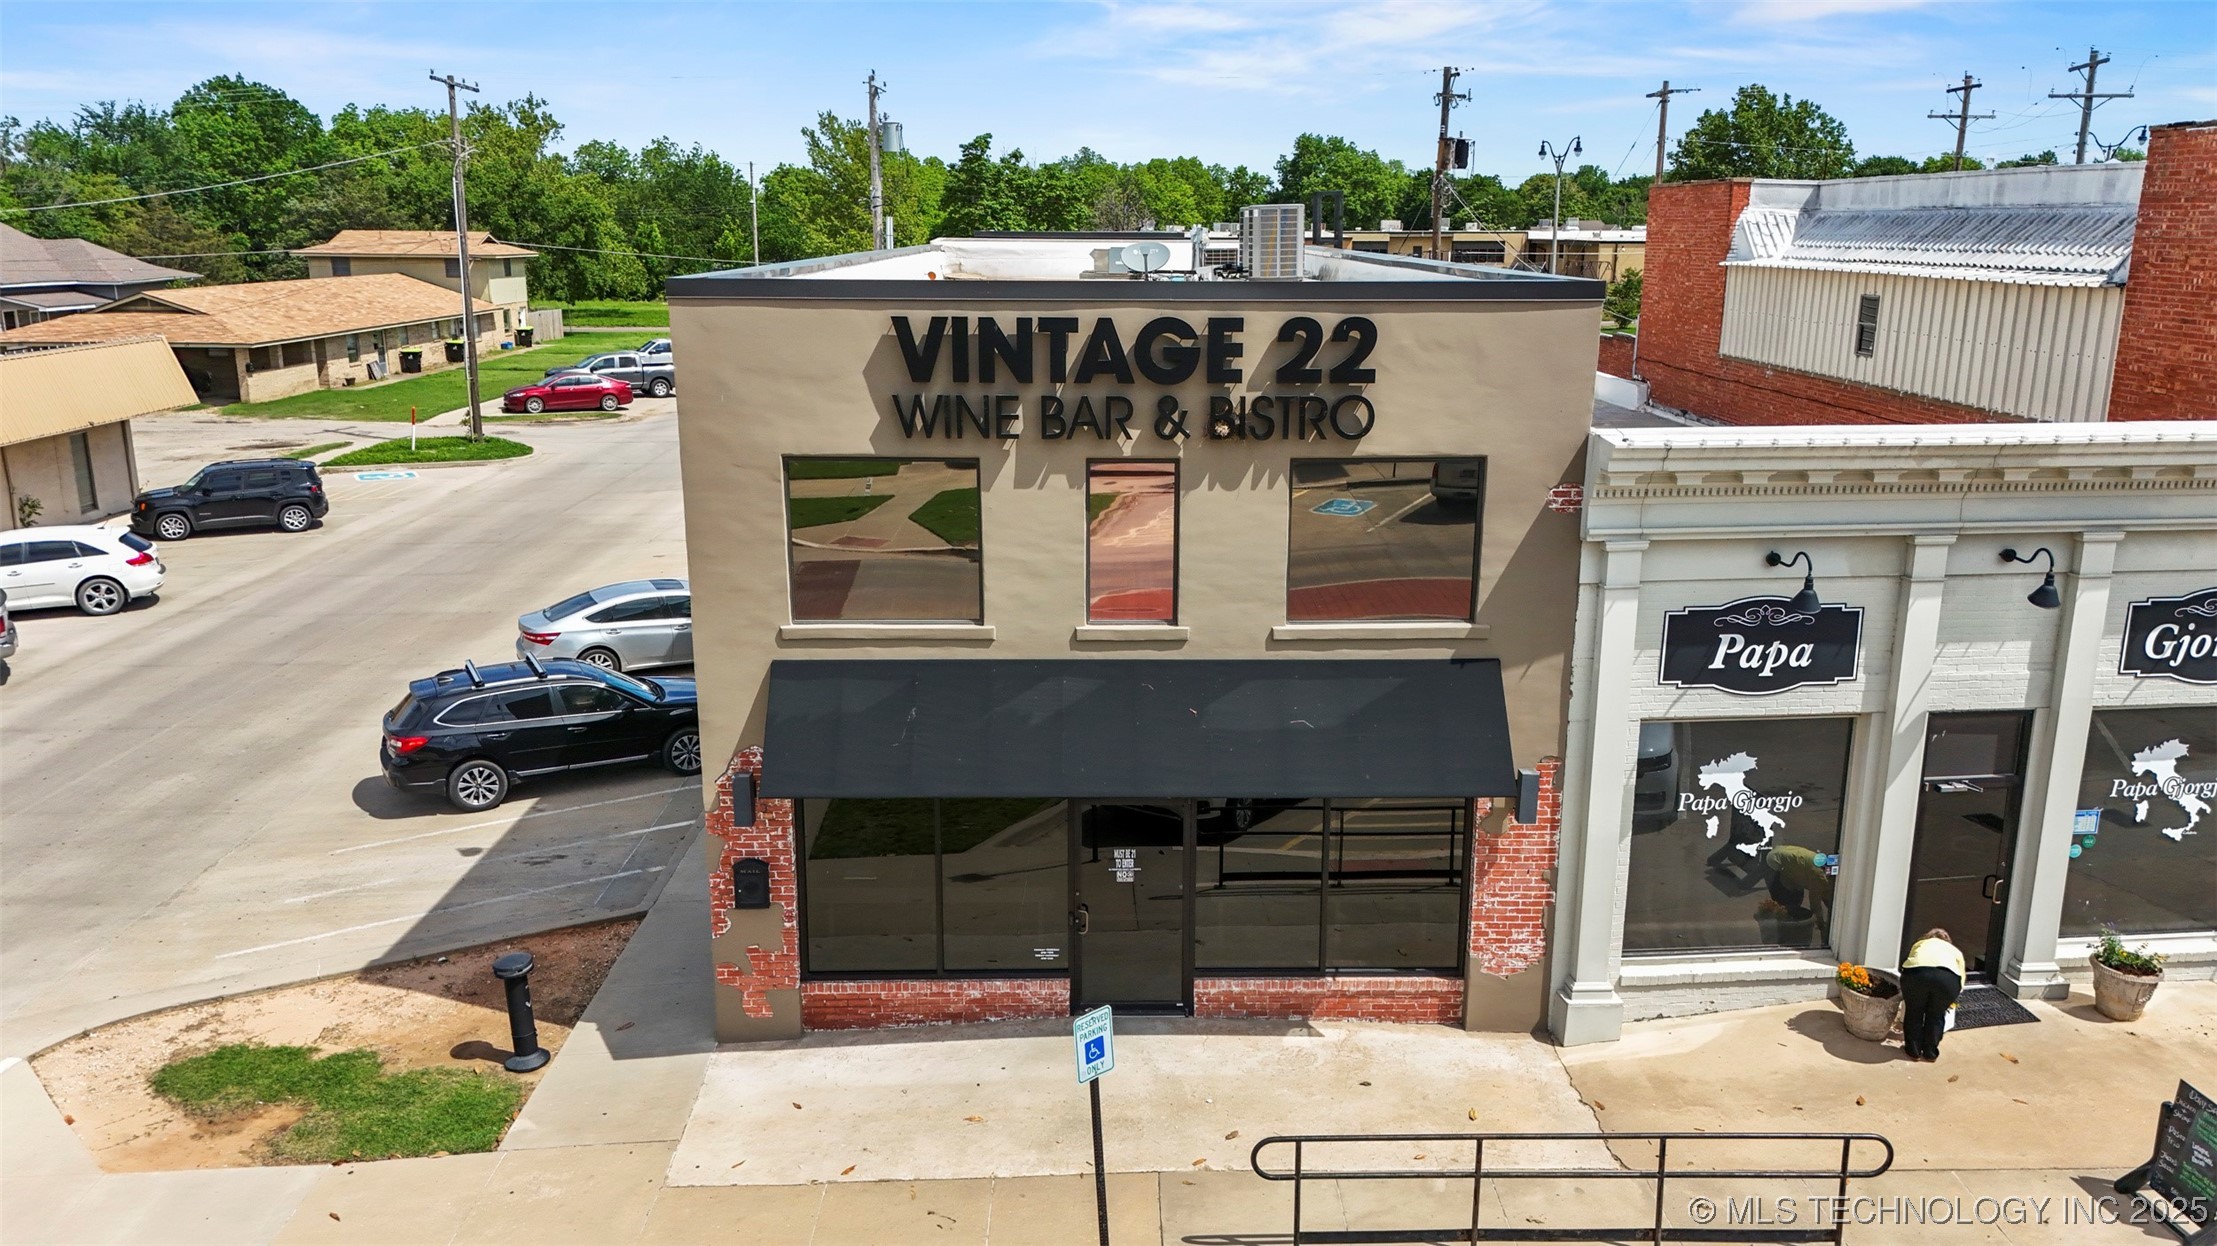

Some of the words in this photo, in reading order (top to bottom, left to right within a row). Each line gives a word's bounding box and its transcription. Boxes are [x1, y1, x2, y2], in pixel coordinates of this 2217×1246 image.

[891, 316, 1244, 384] VINTAGE
[1275, 316, 1378, 384] 22
[893, 394, 1020, 440] WINE
[1040, 394, 1135, 440] BAR
[1154, 395, 1191, 440] &
[1210, 394, 1376, 441] BISTRO
[1708, 633, 1815, 676] Papa
[2109, 778, 2160, 801] Papa
[1677, 792, 1729, 815] Papa
[1732, 789, 1803, 814] Gjorgjo
[1113, 849, 1125, 859] MUST
[1076, 1012, 1109, 1033] RESERVED
[1080, 1023, 1108, 1042] PARKING
[1086, 1061, 1105, 1075] ONLY
